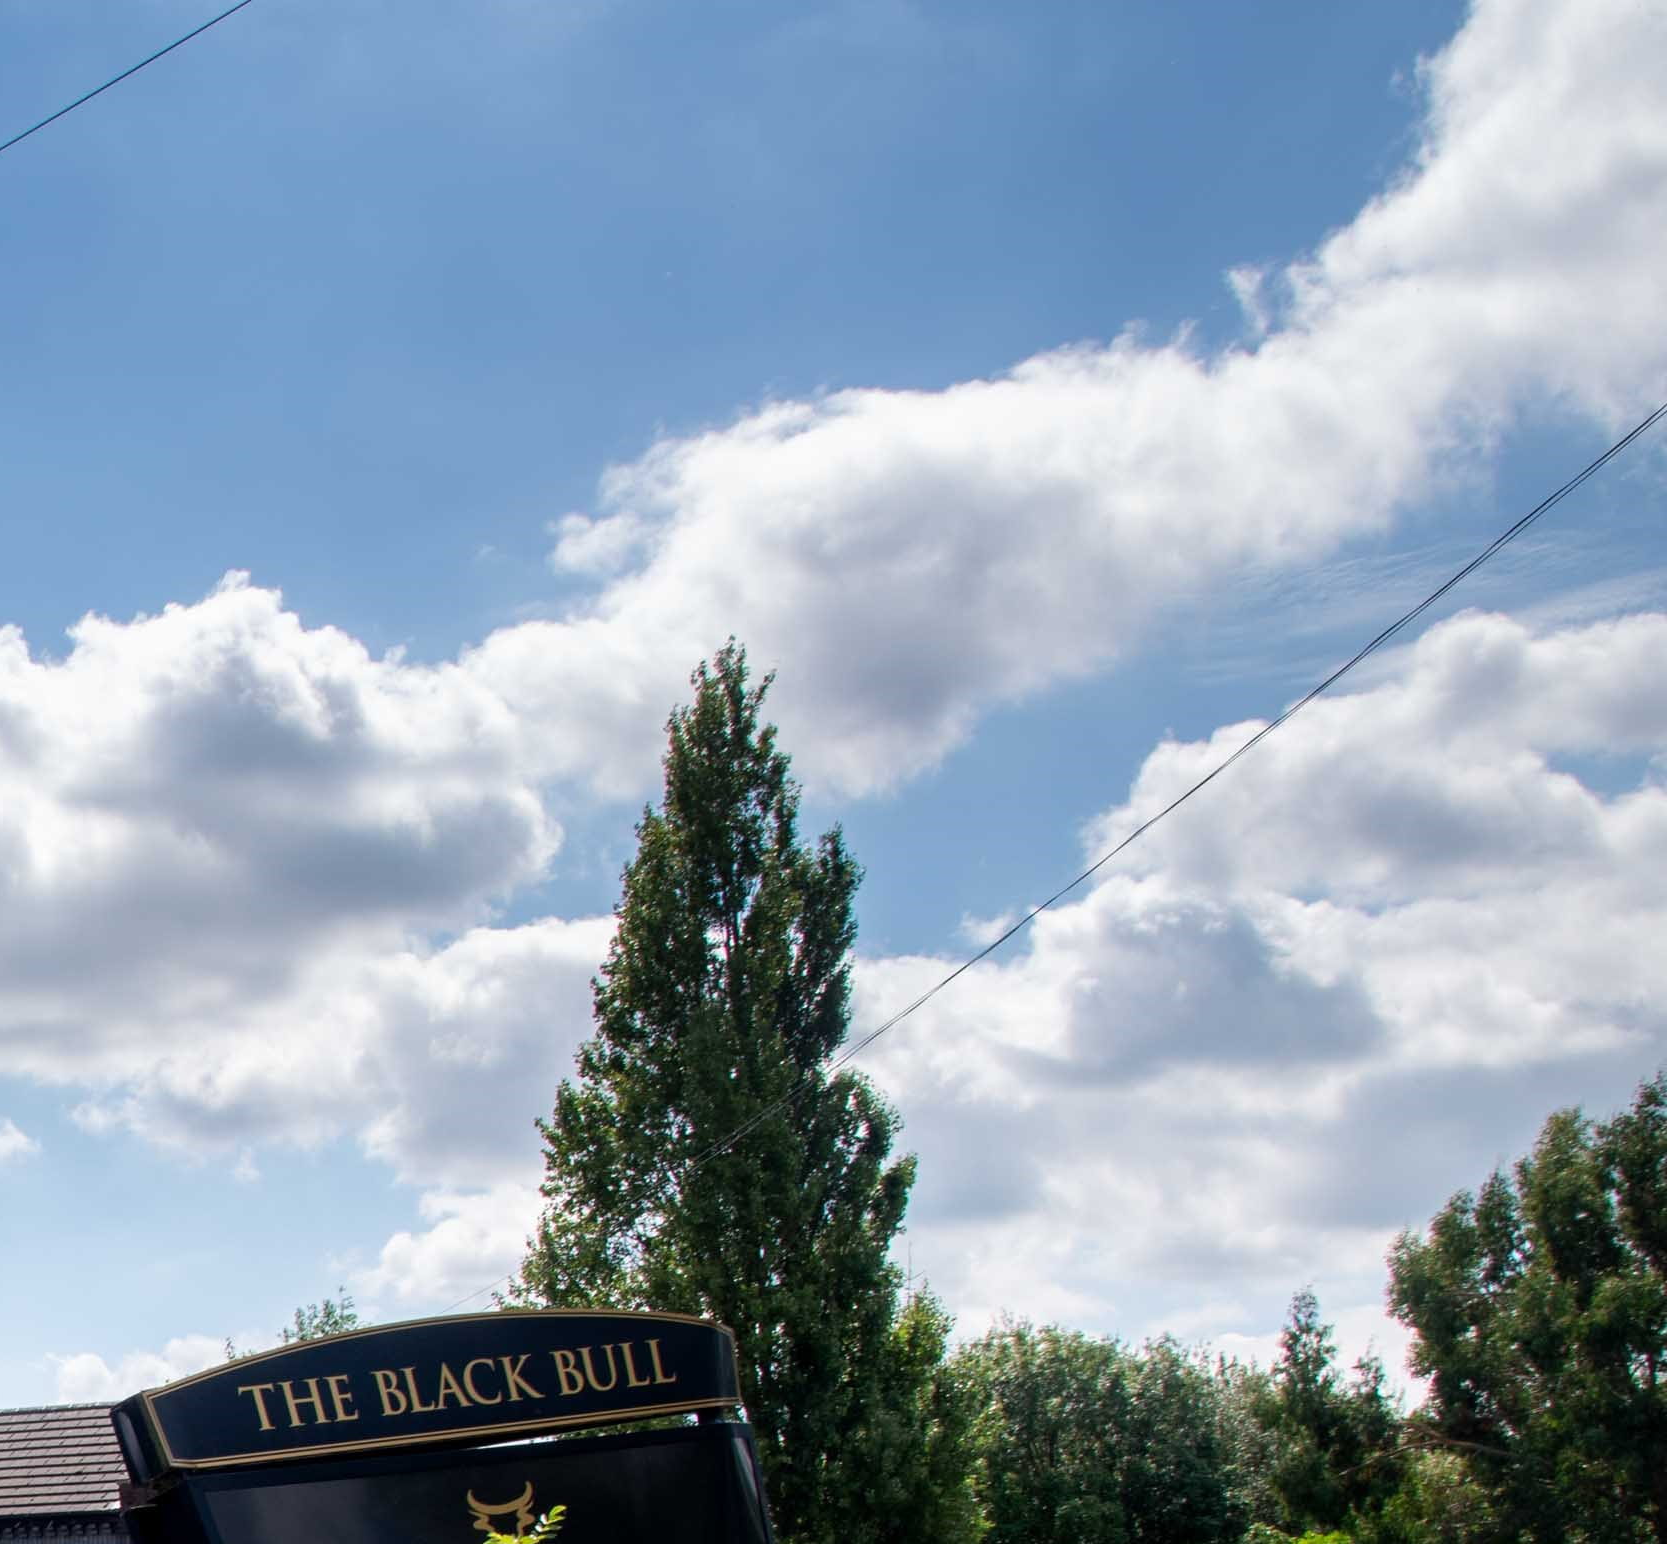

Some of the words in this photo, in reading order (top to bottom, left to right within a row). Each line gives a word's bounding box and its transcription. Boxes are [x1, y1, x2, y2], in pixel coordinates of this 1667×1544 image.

[238, 1374, 359, 1431] THE
[370, 1353, 546, 1416] BLACK
[549, 1339, 677, 1396] BULL
